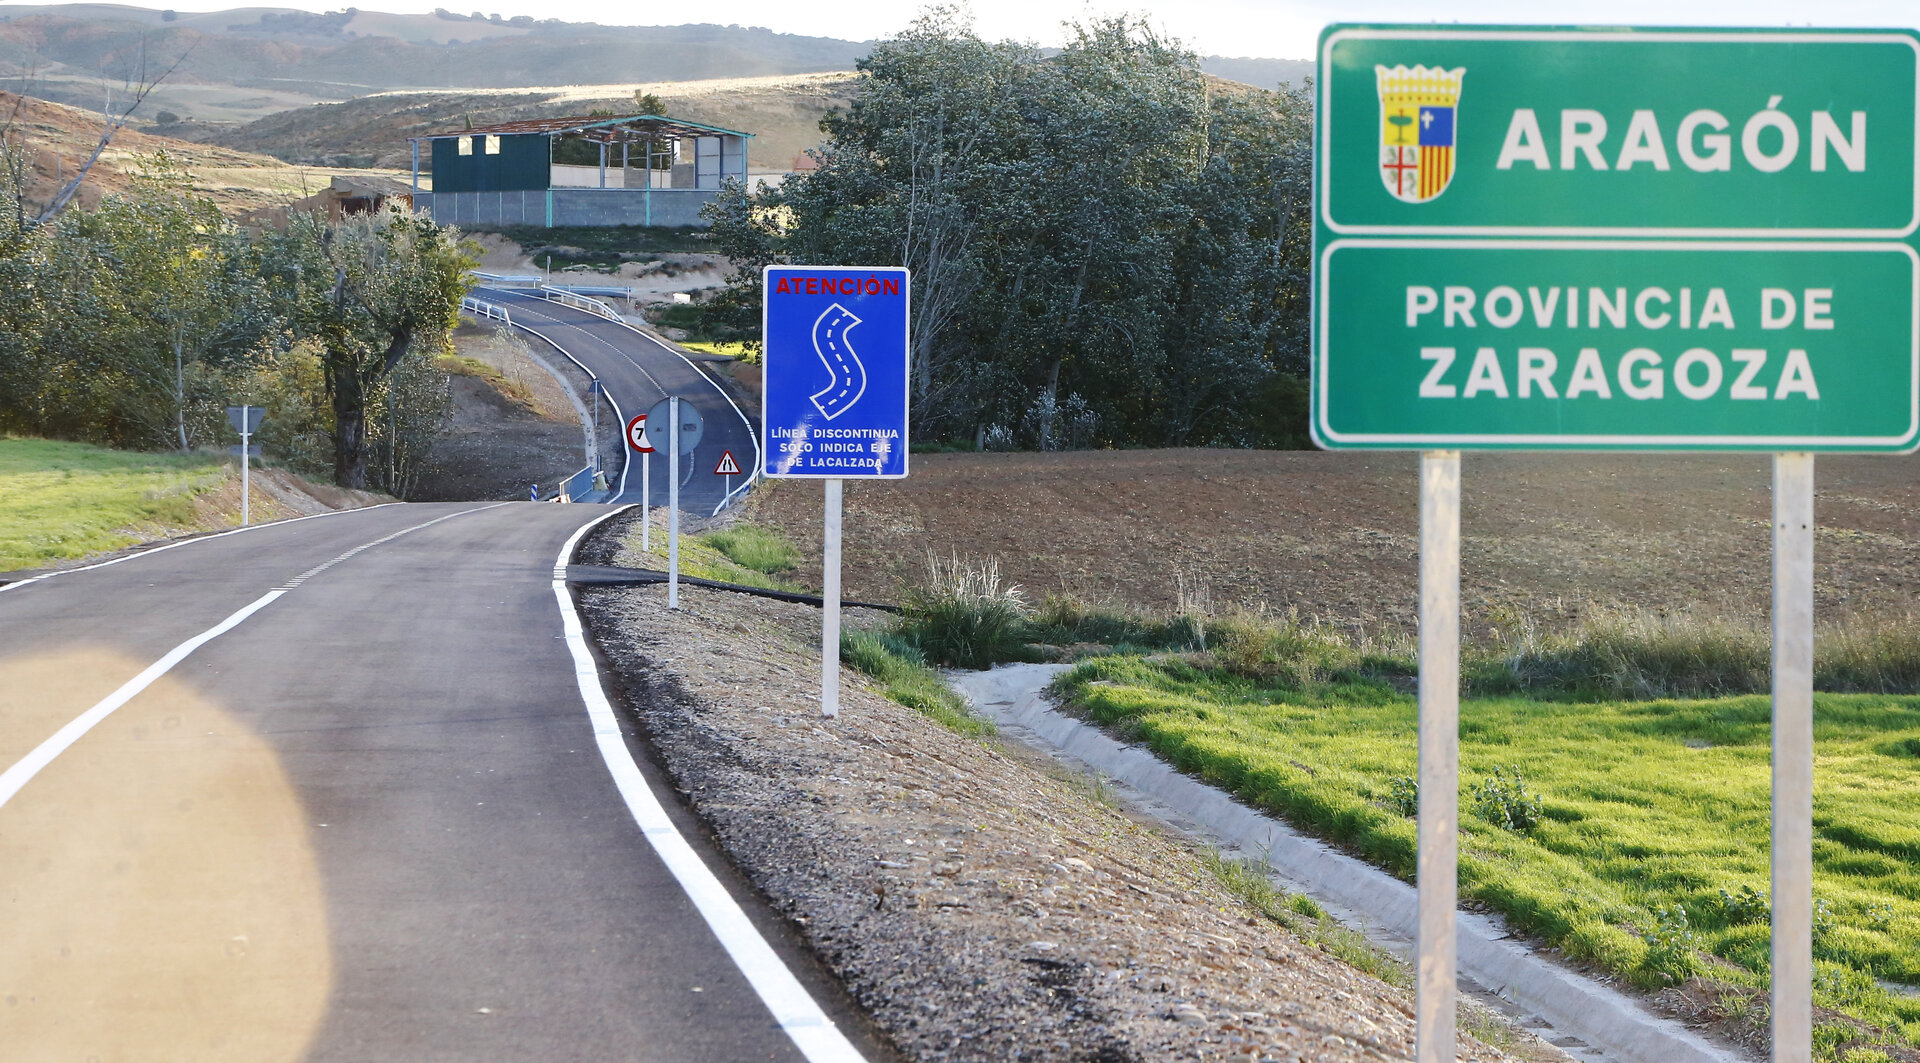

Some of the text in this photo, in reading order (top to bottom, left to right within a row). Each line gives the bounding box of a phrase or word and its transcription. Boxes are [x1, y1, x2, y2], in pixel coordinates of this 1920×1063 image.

[1496, 94, 1867, 173] ARAGÓN
[776, 275, 899, 295] ATENCIÓN
[1406, 285, 1835, 330] PROVINCIA DE
[1419, 347, 1820, 401] ZARAGOZA
[635, 427, 645, 440] 7
[771, 427, 899, 439] LÍNEA DISCONTINUA
[779, 441, 892, 453] SÓLO INDICA EJE
[787, 457, 803, 467] DE
